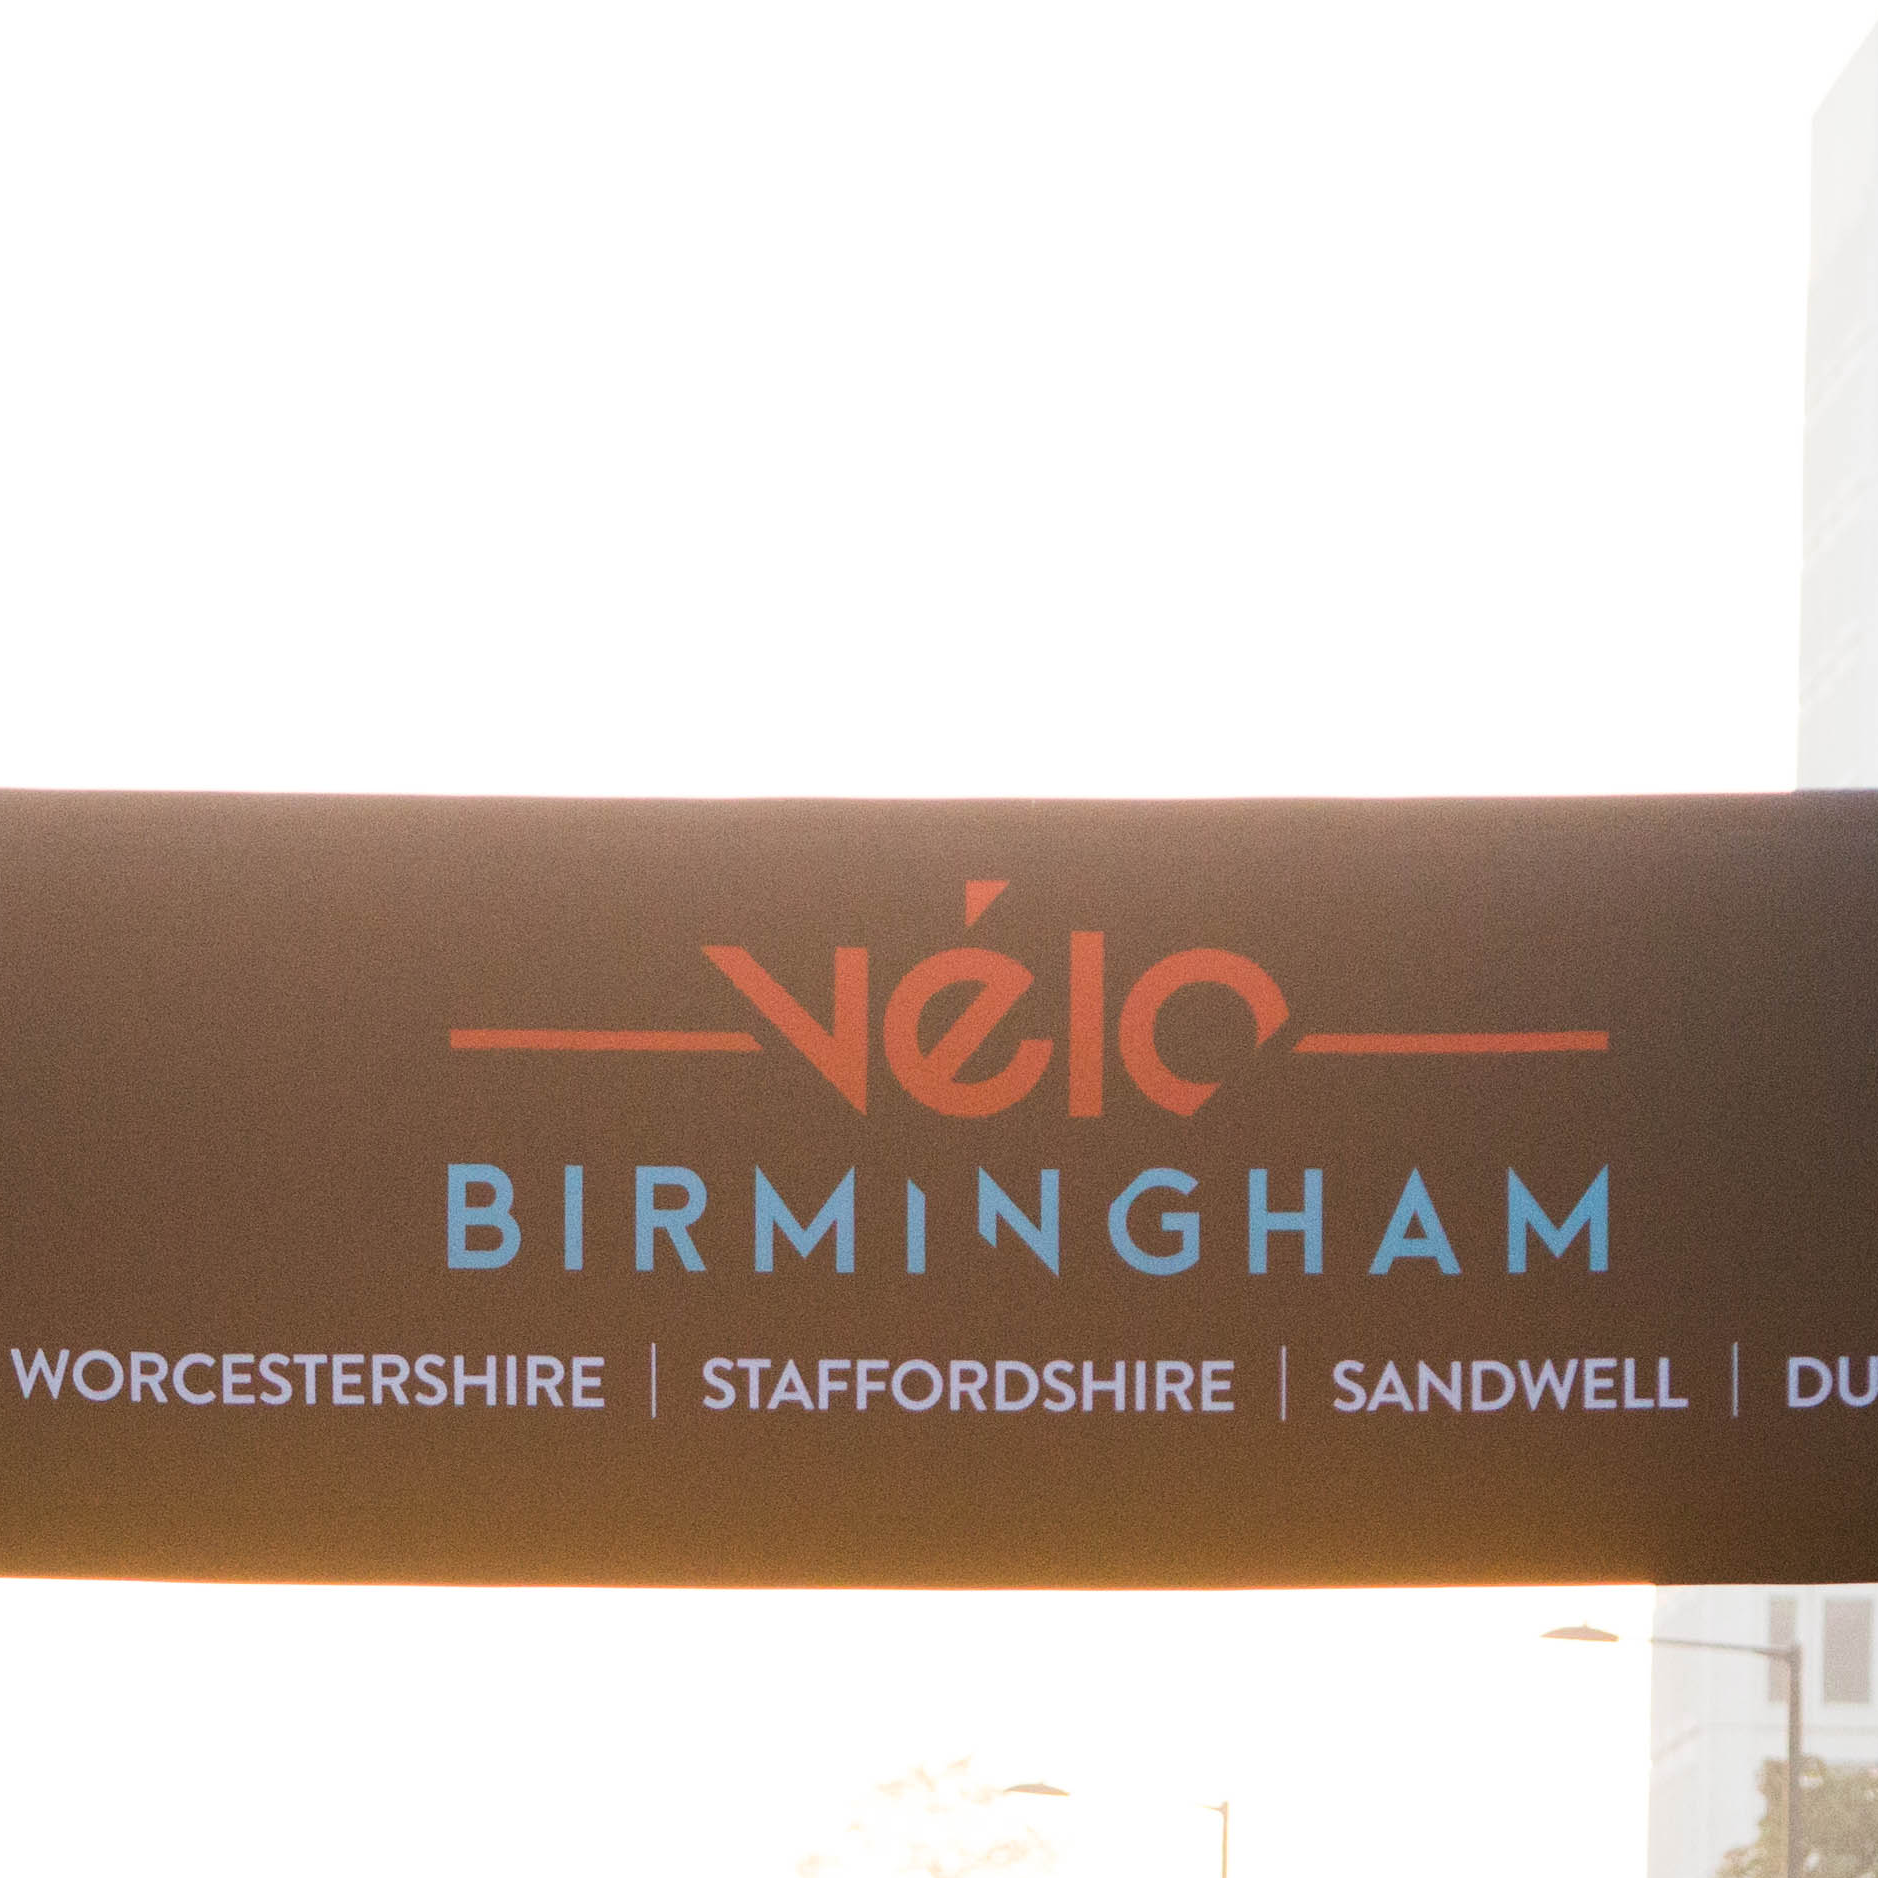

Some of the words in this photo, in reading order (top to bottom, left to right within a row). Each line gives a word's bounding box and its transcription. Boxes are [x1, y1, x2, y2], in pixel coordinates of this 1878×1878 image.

[447, 1163, 1610, 1277] BIRMINGHAM
[11, 1348, 606, 1408] WORCESTERSHIRE
[702, 1357, 1235, 1412] STAFFORDSHIRE
[1332, 1357, 1689, 1412] SANDWELL
